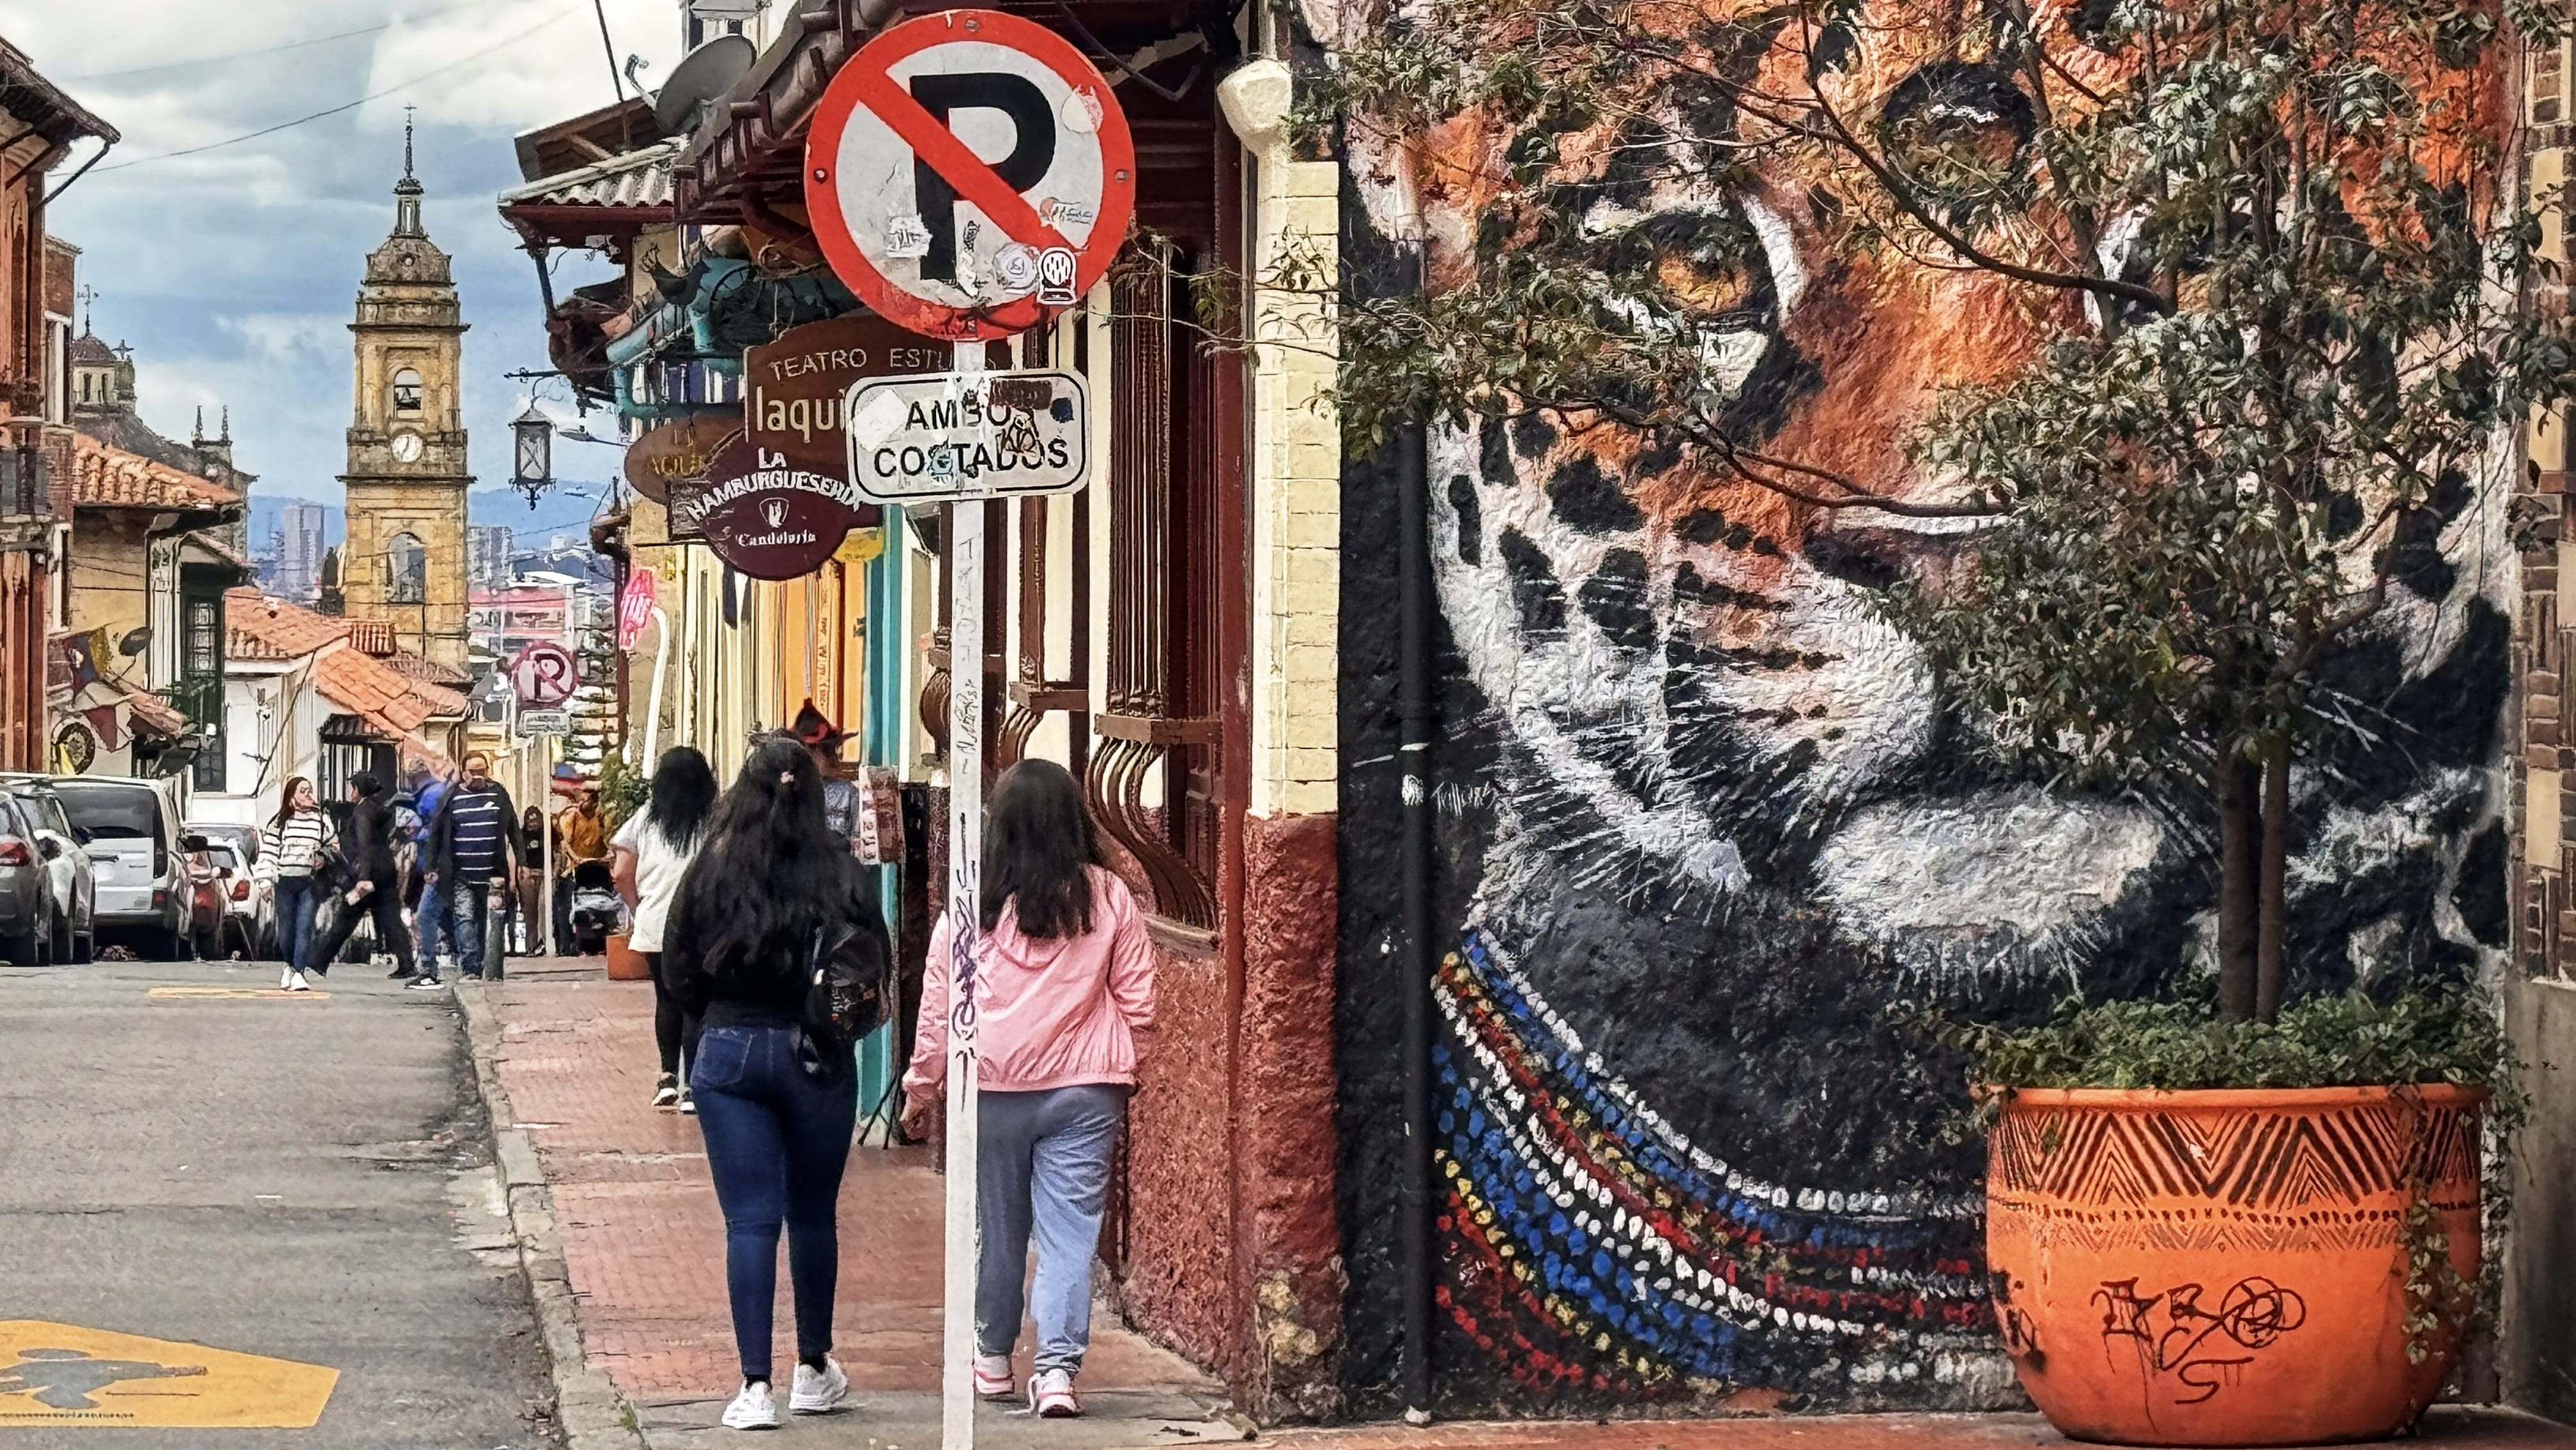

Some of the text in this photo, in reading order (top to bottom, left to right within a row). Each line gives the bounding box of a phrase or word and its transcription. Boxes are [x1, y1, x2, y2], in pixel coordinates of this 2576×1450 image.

[910, 72, 1056, 280] P
[769, 348, 868, 381] TEATRO
[905, 399, 1035, 431] AMBO
[758, 446, 786, 469] LA
[873, 436, 1069, 478] COTADOS
[534, 653, 566, 699] P
